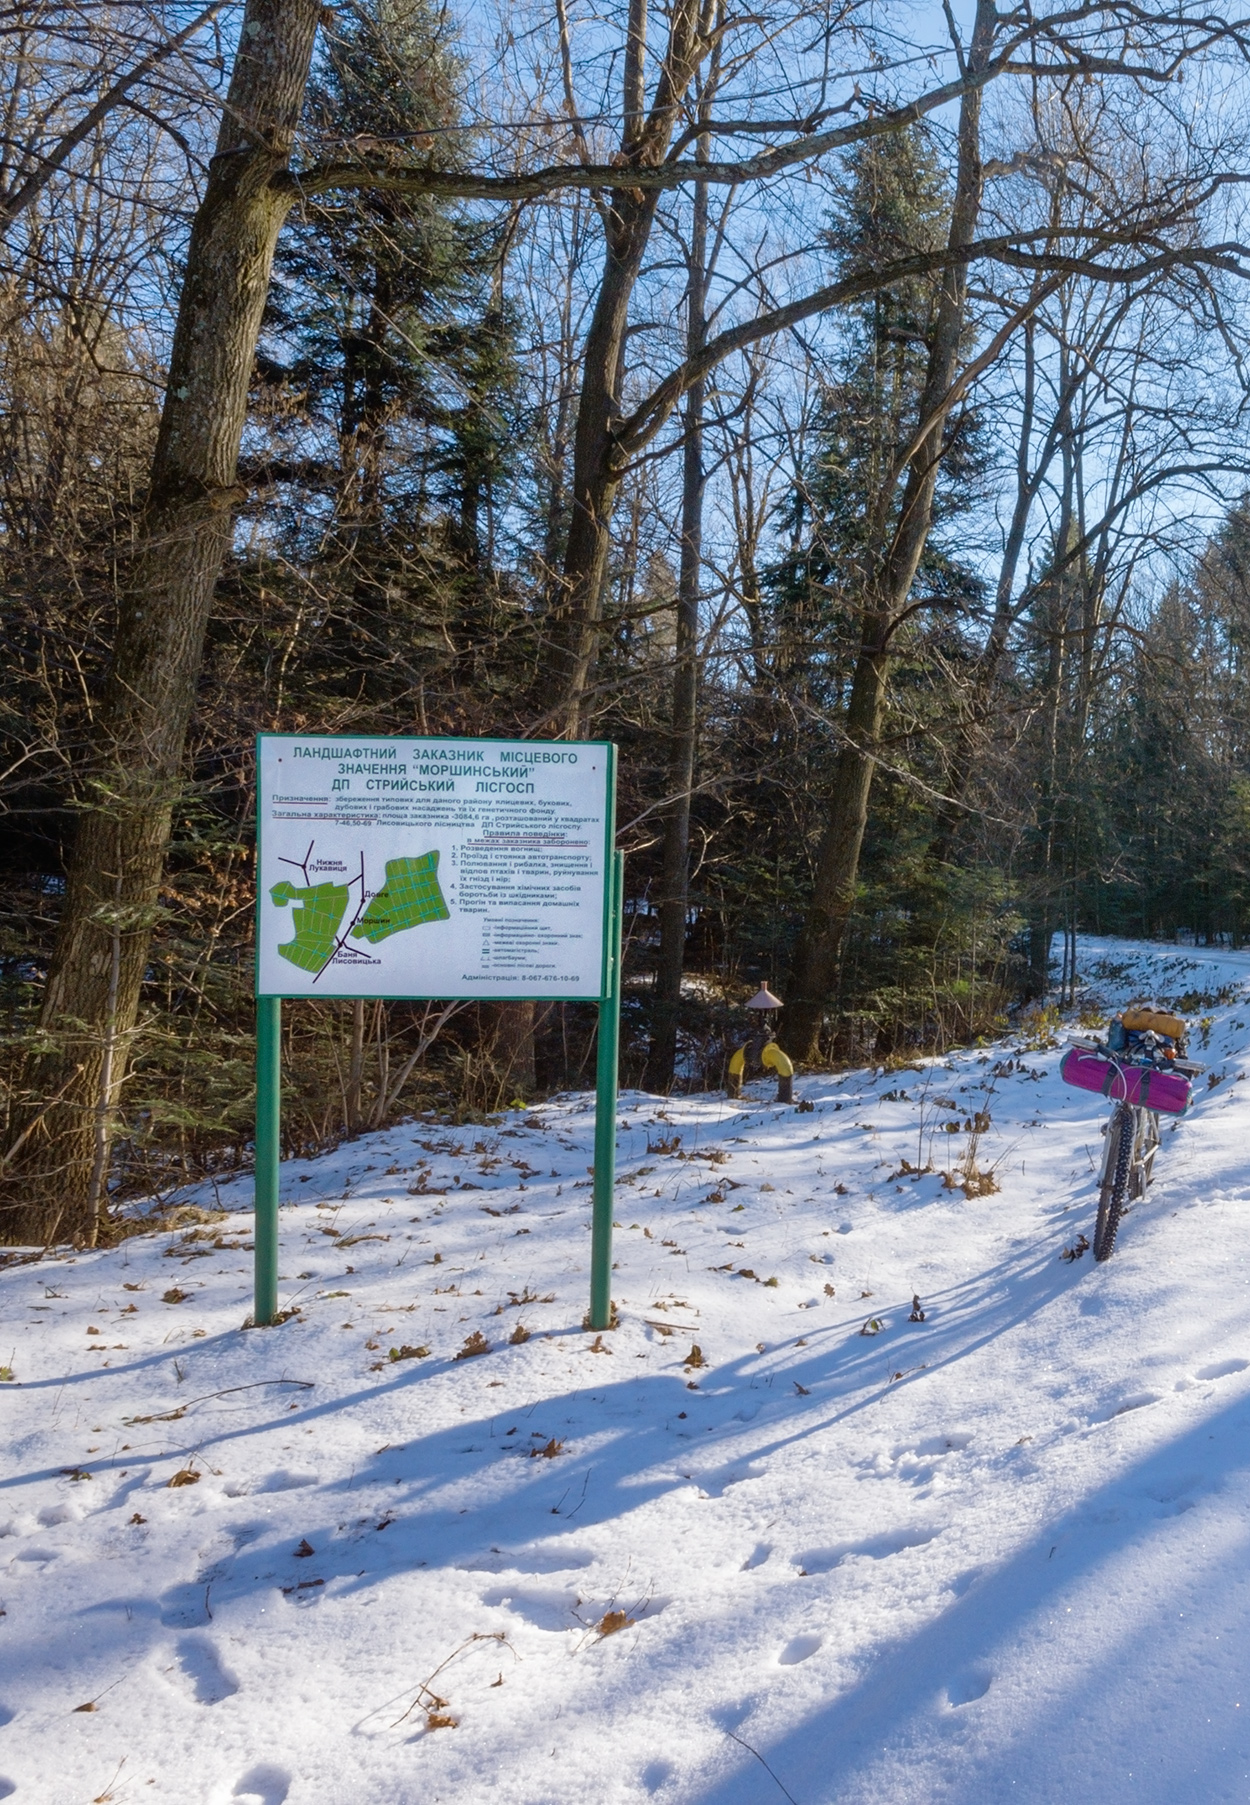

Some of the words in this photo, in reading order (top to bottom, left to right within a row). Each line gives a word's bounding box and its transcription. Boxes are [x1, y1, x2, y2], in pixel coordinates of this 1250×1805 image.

[293, 746, 397, 760] ЛАНДШАФТНИЙ
[412, 748, 485, 762] ЗАКАЗНИК
[500, 751, 578, 764] МІСЦЕВОГО
[338, 763, 406, 775] ЗНАЧЕННЯ
[412, 764, 535, 778] “МОРШИНСЬКИЙ”
[332, 779, 350, 792] ДП
[366, 778, 455, 792] СТРИЙСЬКИЙ
[475, 781, 534, 794] ЛІСГОСП
[272, 794, 331, 802] Призначення:
[335, 795, 379, 803] збереження
[463, 797, 492, 806] району
[495, 799, 536, 807] ялицевих,
[373, 804, 409, 812] грабових
[313, 812, 381, 820] характеристика:
[376, 820, 433, 828] Лисовицького
[434, 820, 475, 829] лісництва
[496, 822, 547, 830] Стрийського
[548, 822, 582, 831] лісгоспу.
[482, 829, 521, 837] Правила
[523, 830, 568, 838] поведінки:
[460, 852, 489, 860] Проїзд
[309, 864, 347, 872] Лукавиця
[553, 869, 599, 877] руйнування
[459, 882, 516, 891] Застосування
[458, 890, 499, 898] боротьби
[459, 898, 486, 906] Прогін
[357, 916, 391, 925] Моршин
[462, 974, 519, 982] Адміністрація:
